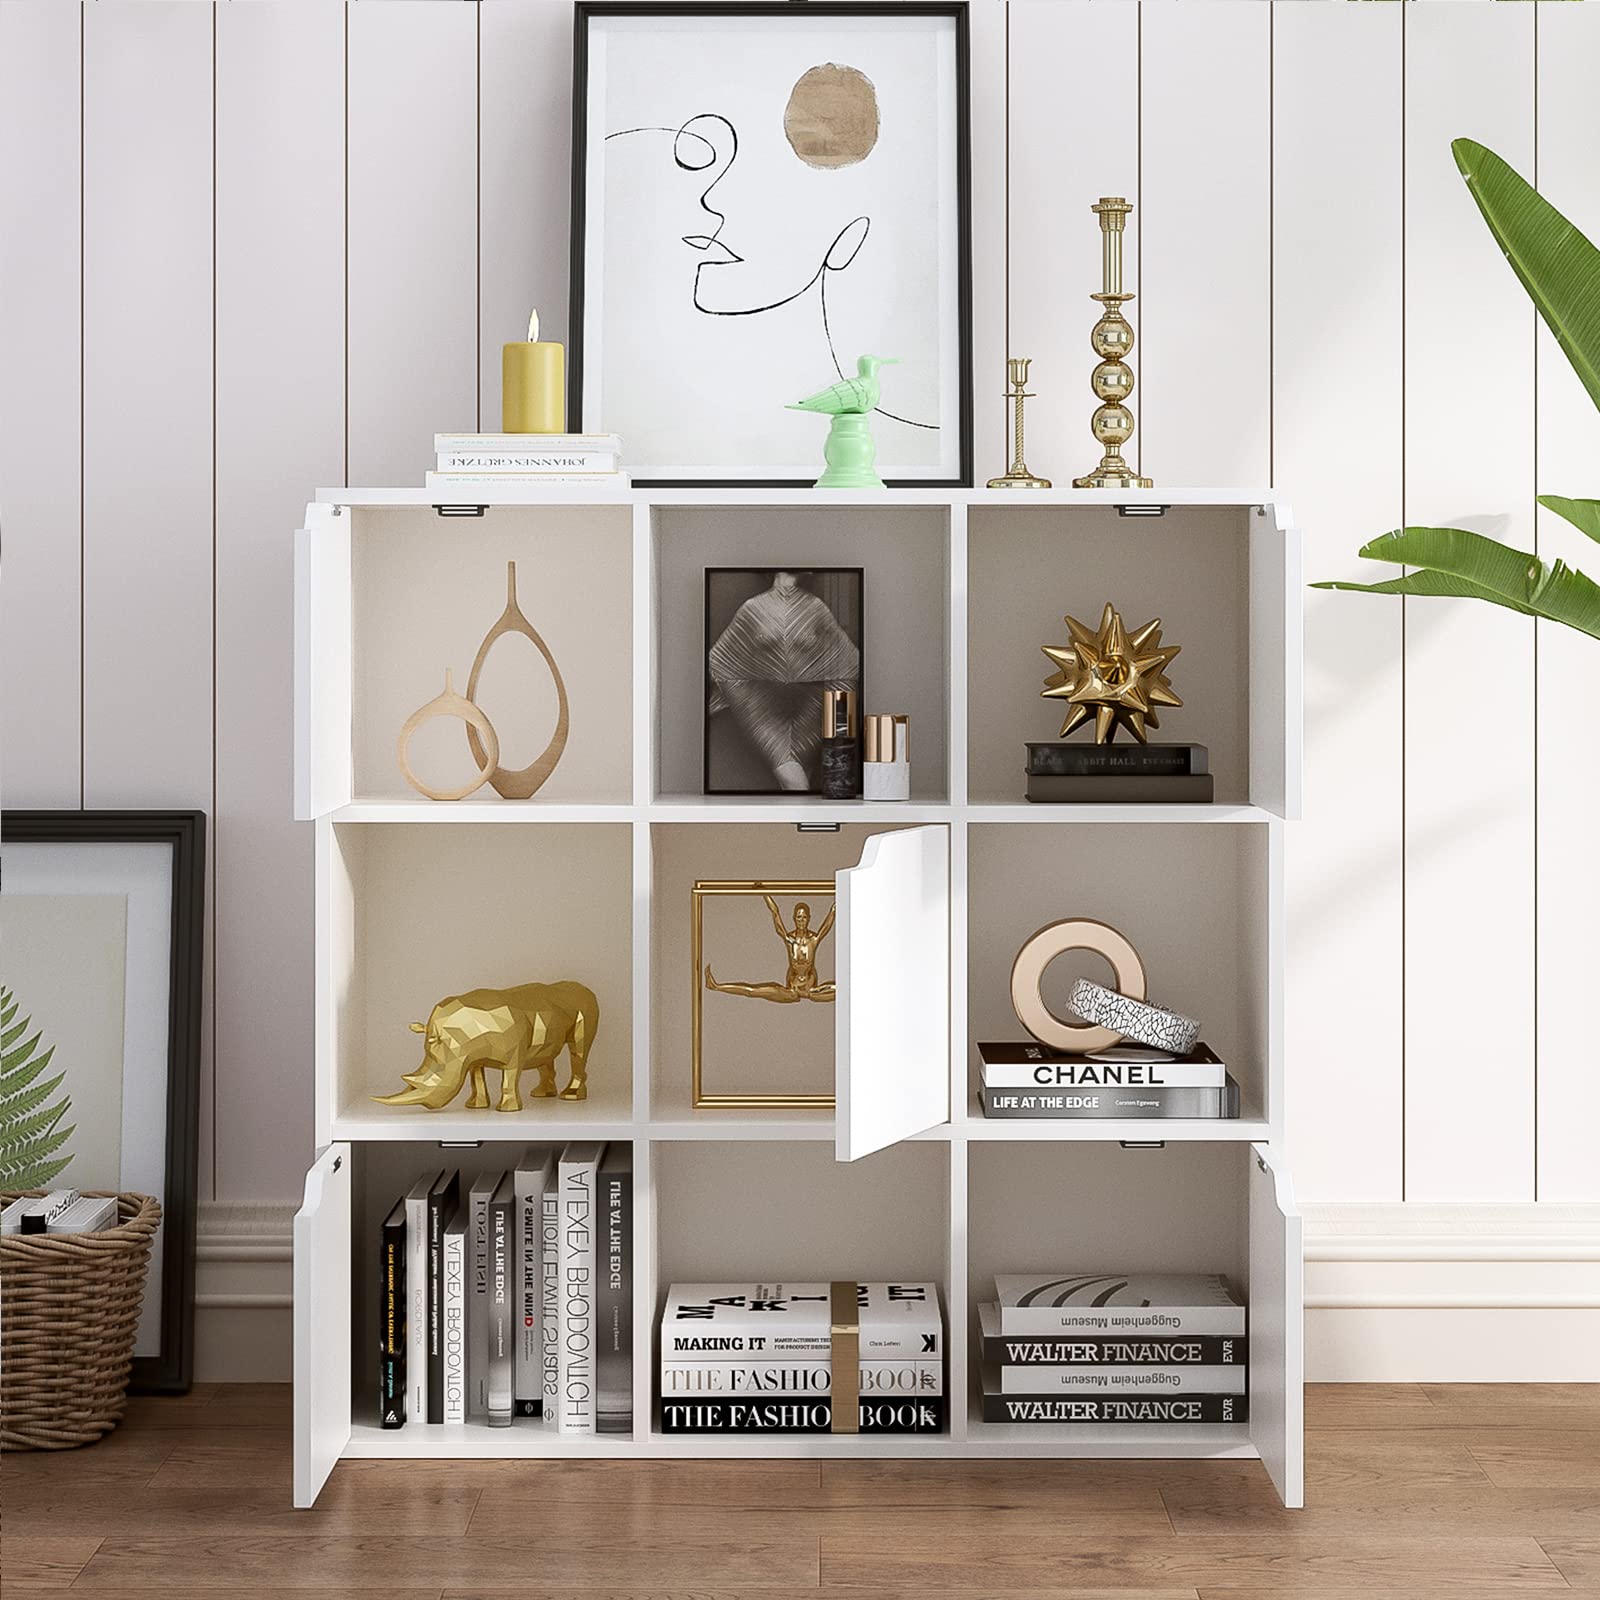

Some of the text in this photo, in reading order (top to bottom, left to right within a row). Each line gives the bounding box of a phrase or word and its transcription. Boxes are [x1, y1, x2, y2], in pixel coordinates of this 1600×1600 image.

[514, 458, 586, 466] JOHANNES
[1033, 1066, 1165, 1084] CHANEL
[993, 1096, 1099, 1109] LIFE AT THE EDGE
[1061, 1315, 1181, 1328] Guggenheim Museum
[673, 1337, 766, 1351] MAKING IT
[1006, 1344, 1202, 1362] WALTER FINANCE
[1223, 1340, 1233, 1363] EVR
[665, 1369, 722, 1391] THE
[729, 1369, 831, 1391] FASHIO
[1061, 1374, 1181, 1386] Guggenheim Museum
[664, 1405, 722, 1427] THE
[729, 1405, 831, 1427] FASHIO
[1006, 1402, 1202, 1420] WALTER FINANCE
[1223, 1398, 1233, 1421] EVR
